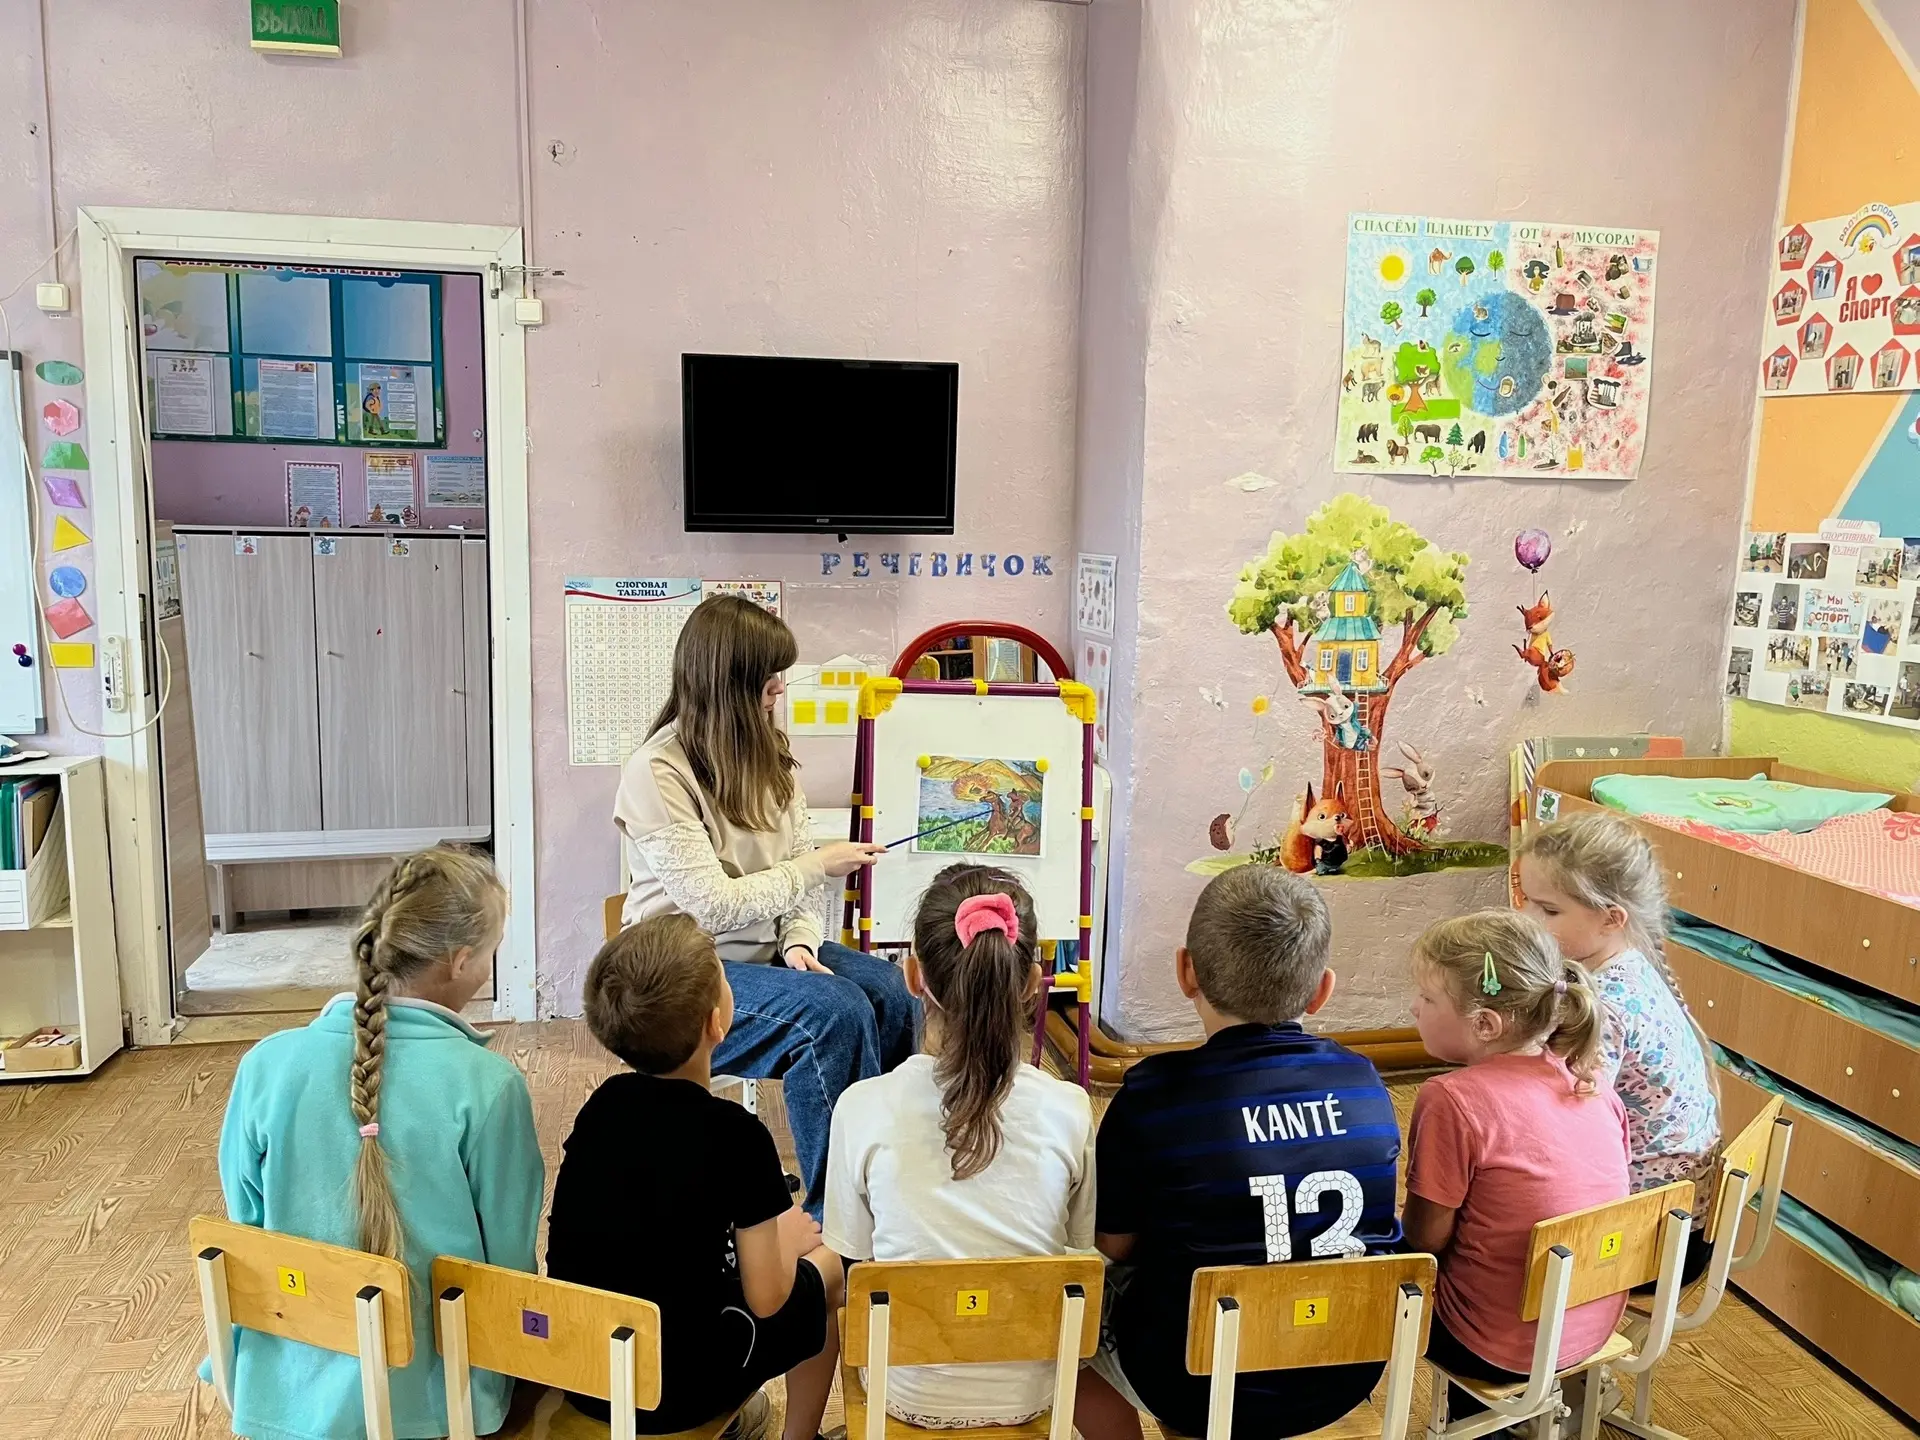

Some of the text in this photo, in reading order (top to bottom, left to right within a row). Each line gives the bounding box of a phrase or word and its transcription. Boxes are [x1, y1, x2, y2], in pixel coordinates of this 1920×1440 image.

[1871, 204, 1899, 229] СПОРТА
[1354, 218, 1635, 246] СПАСЁМ ПЛАНЕТУ ОТ МУСОРА!
[1845, 276, 1858, 302] Я
[1839, 296, 1891, 323] СПОРТ
[1821, 531, 1875, 544] СПОРТИВНЫЕ
[820, 551, 1054, 578] РЕЧЕВИЧОК
[615, 581, 668, 589] СЛОГОВАЯ
[617, 589, 666, 597] ТАБЛИЦА
[1827, 594, 1843, 605] Мы
[1241, 1092, 1348, 1143] KANTÉ
[1248, 1169, 1367, 1263] 12
[1606, 1238, 1614, 1252] 3
[287, 1273, 297, 1288] 3
[966, 1295, 977, 1310] 3
[1305, 1303, 1316, 1319] 3
[530, 1317, 540, 1333] 2
